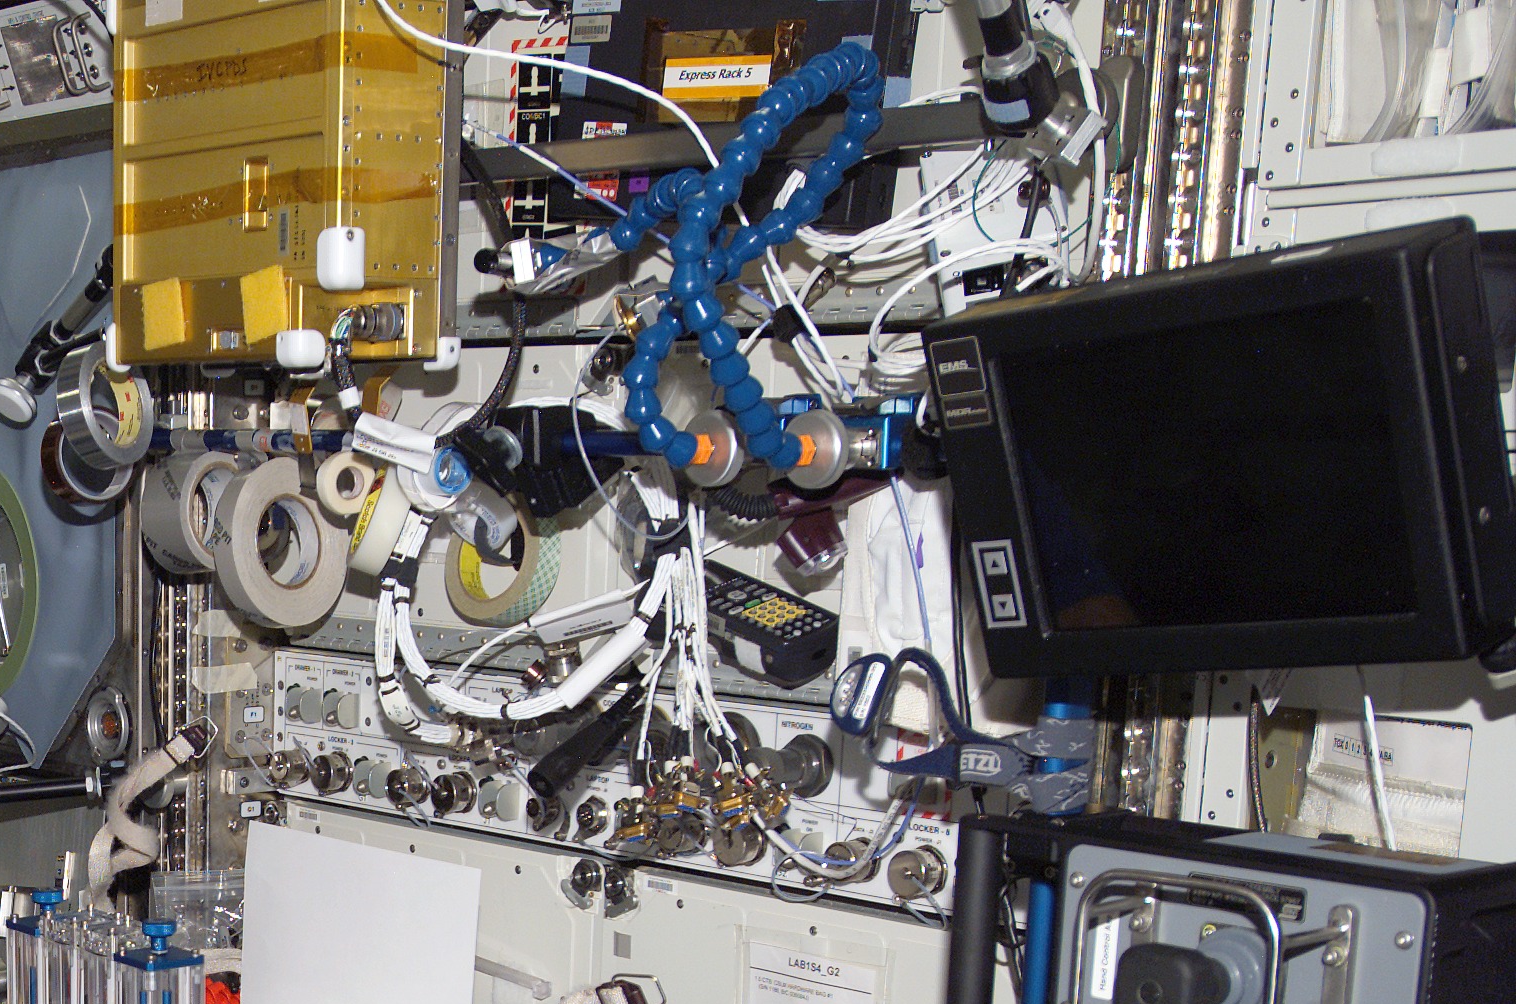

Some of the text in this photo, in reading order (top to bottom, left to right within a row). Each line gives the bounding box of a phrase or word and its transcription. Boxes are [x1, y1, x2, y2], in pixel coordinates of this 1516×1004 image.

[679, 68, 752, 82] Express Rack 5
[908, 823, 938, 835] LOCKER
[1101, 933, 1110, 966] Control
[788, 957, 840, 977] LAB1S4_G2
